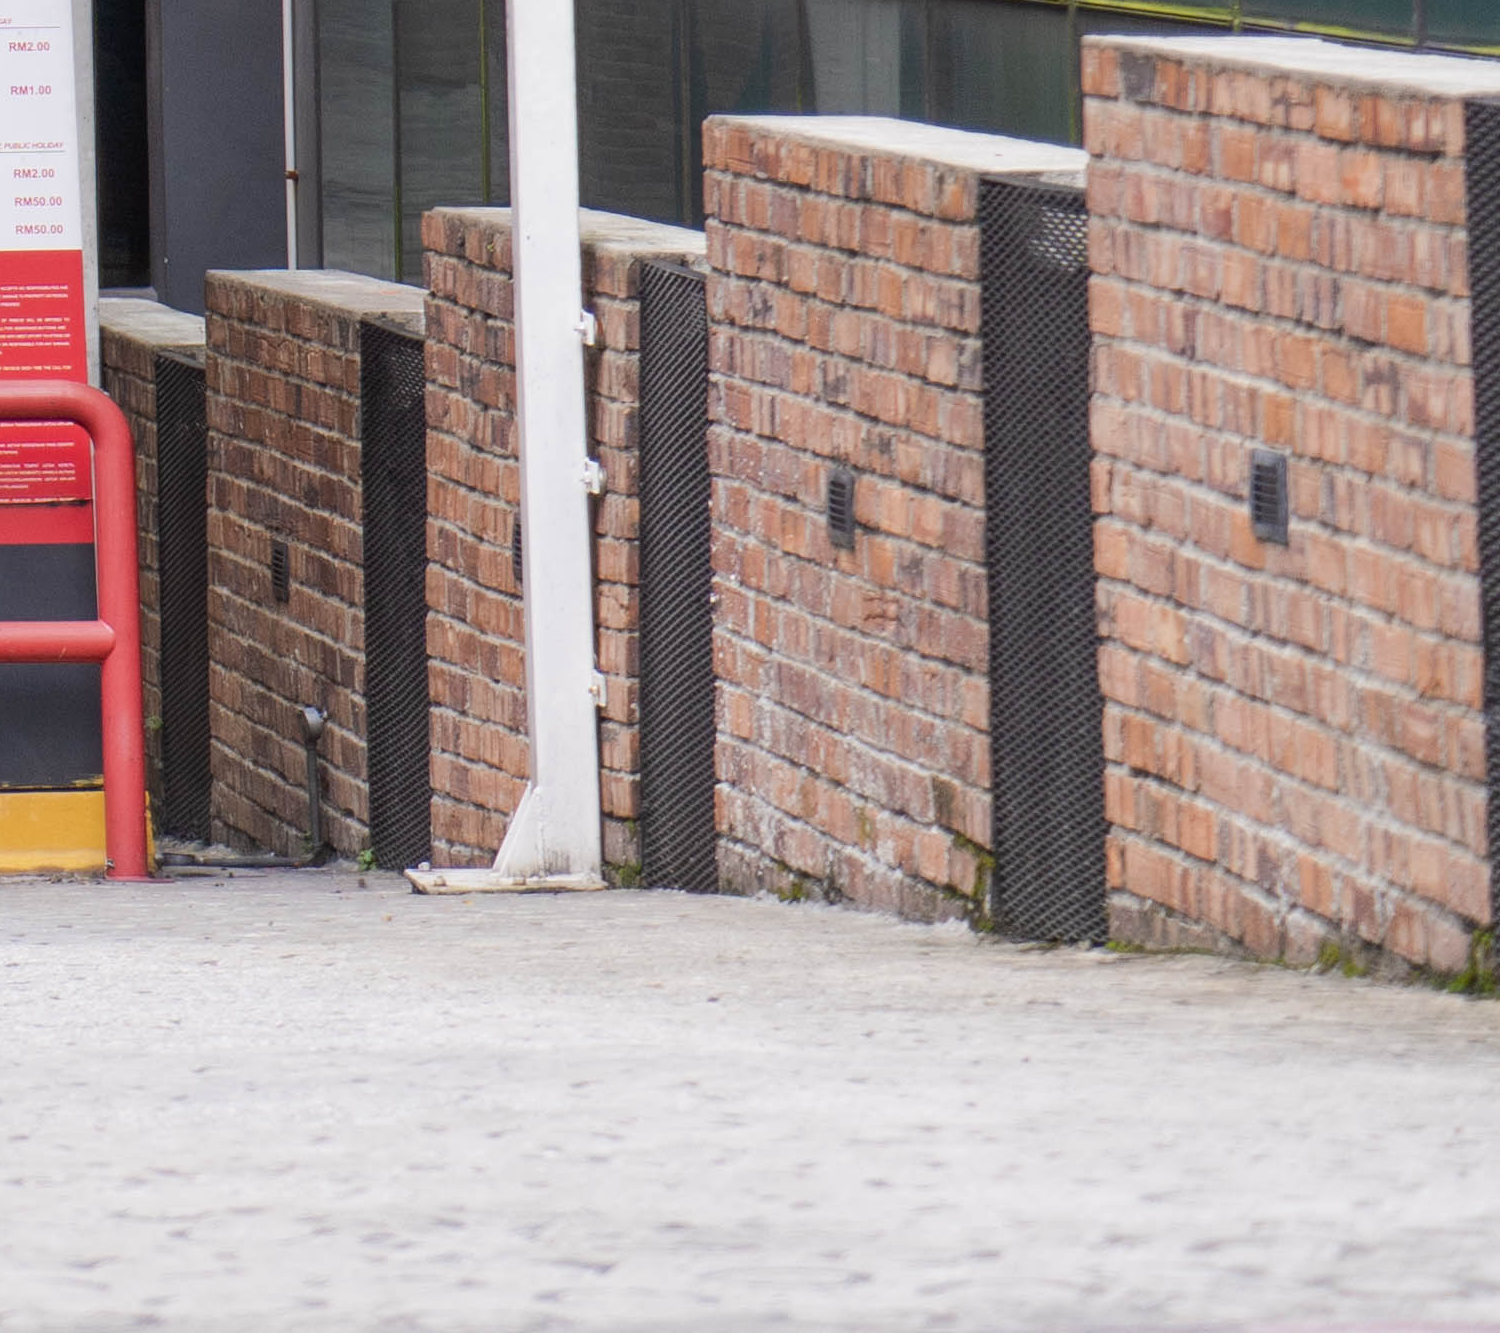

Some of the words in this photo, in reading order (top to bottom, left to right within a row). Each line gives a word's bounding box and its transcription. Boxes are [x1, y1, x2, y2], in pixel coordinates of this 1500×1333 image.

[9, 42, 50, 52] RM2.00
[11, 85, 51, 96] RM1.00
[14, 169, 54, 179] RM2.00
[15, 197, 62, 207] RM50.00
[16, 225, 63, 234] RM50.00
